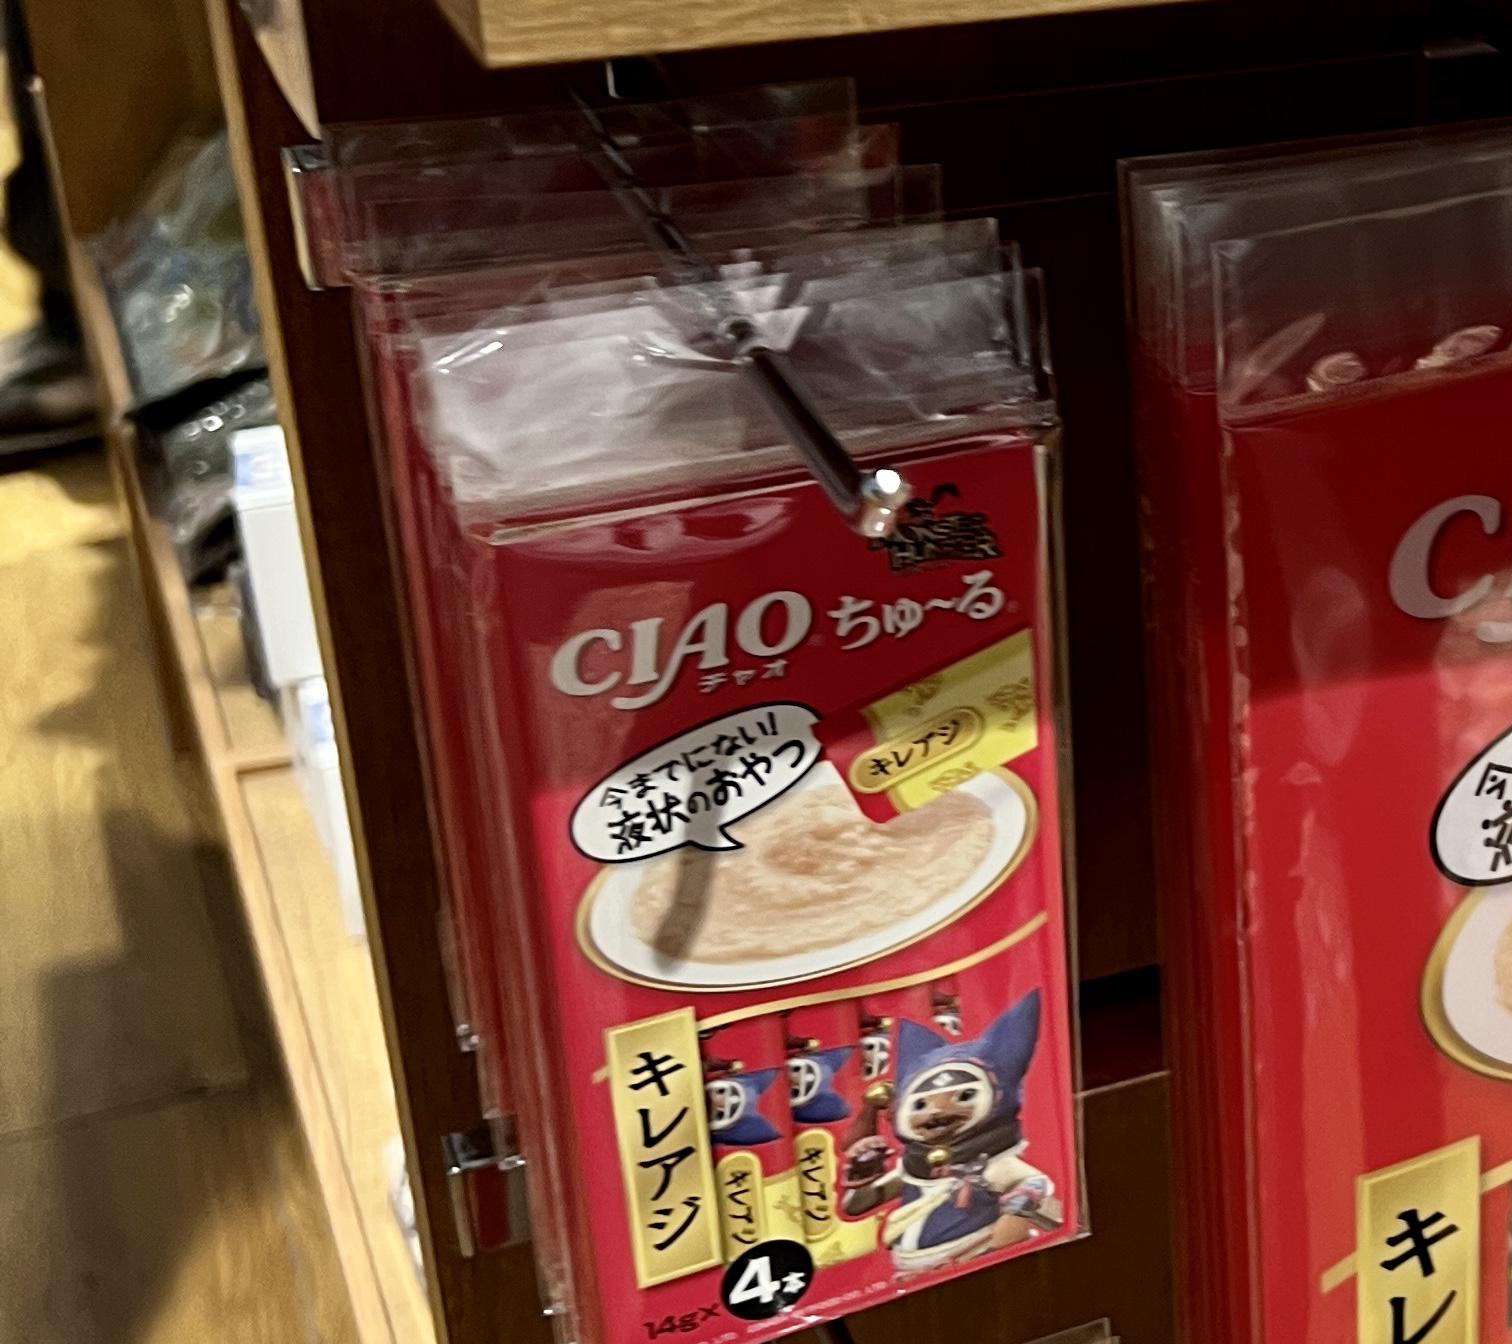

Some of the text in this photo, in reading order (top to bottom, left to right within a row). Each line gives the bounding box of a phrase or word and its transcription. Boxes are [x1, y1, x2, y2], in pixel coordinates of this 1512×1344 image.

[548, 590, 812, 711] CIAO
[608, 739, 807, 855] 液状のおやつ
[866, 719, 961, 777] キレアジ
[628, 1051, 702, 1251] キレアジ
